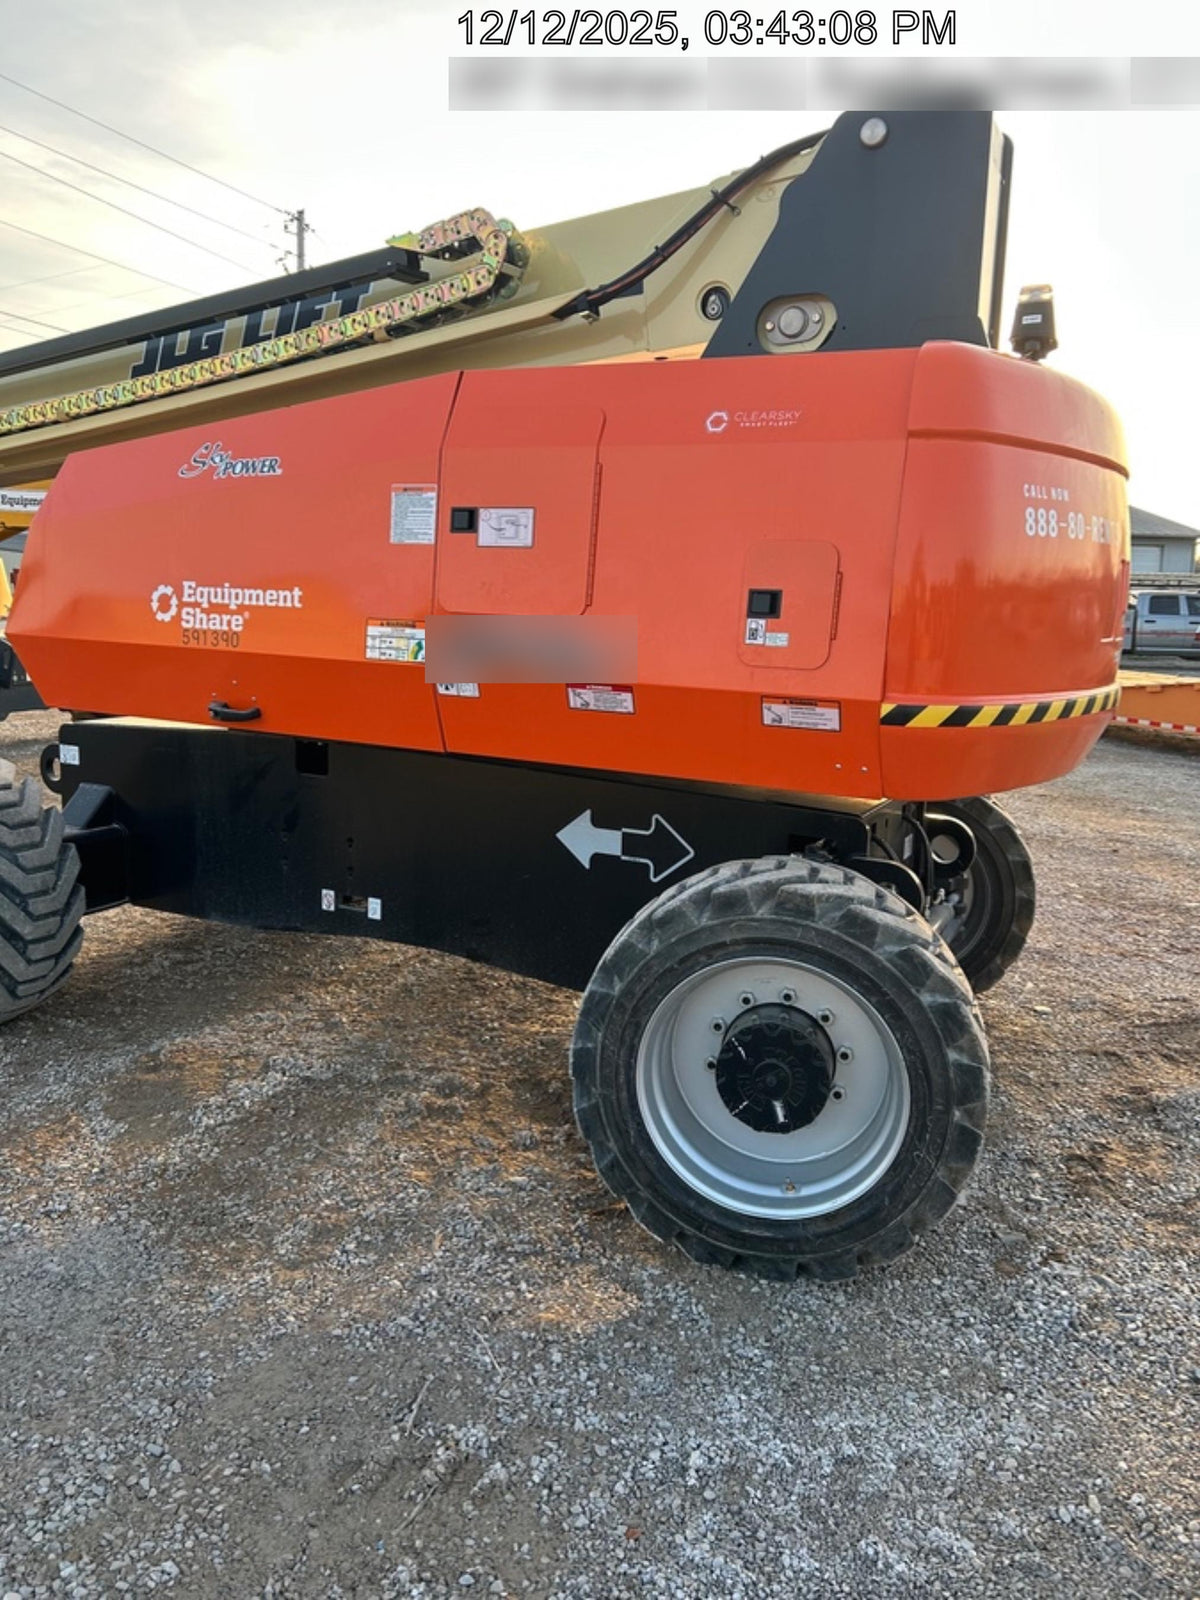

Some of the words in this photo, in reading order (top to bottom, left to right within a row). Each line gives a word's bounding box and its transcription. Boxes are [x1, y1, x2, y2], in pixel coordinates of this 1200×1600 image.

[242, 282, 375, 349] LIFT
[734, 410, 802, 422] CLEARSKY
[219, 456, 283, 478] POWER
[1023, 483, 1049, 499] CALL
[182, 581, 303, 610] Equipment
[181, 629, 240, 648] 591390
